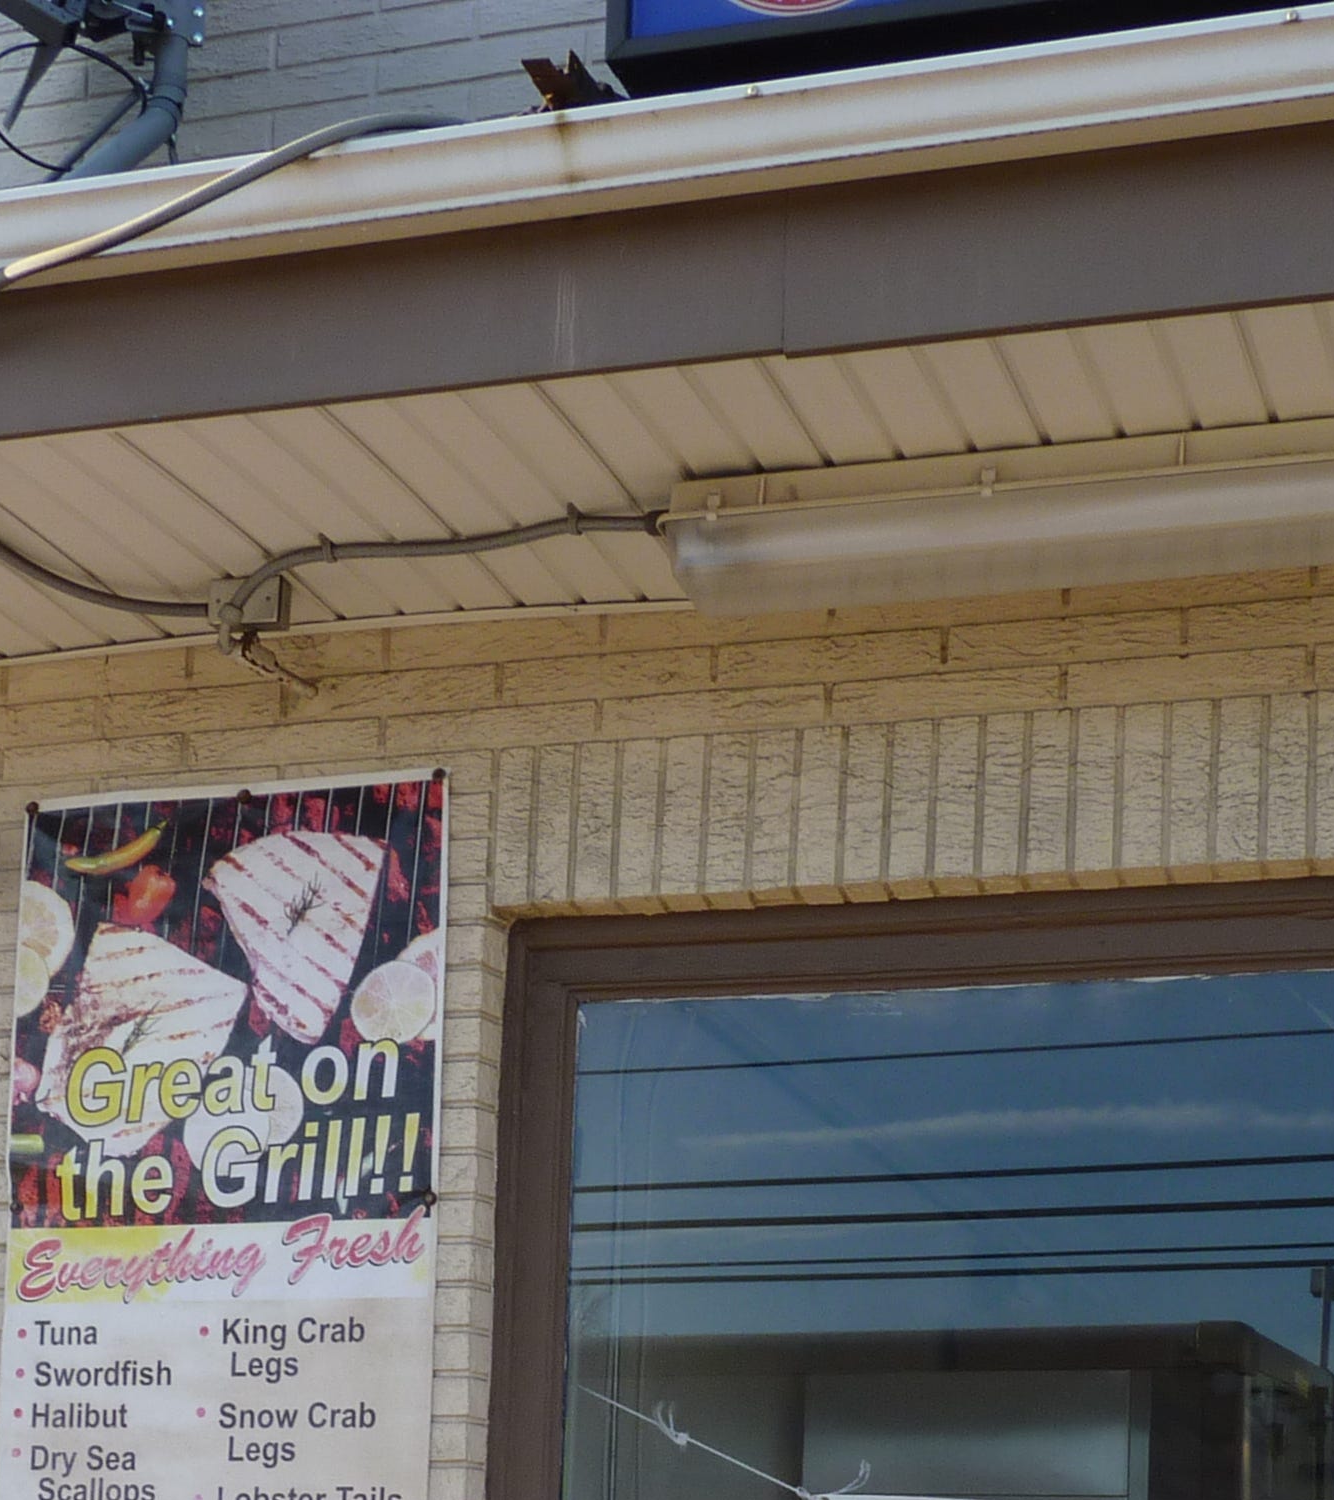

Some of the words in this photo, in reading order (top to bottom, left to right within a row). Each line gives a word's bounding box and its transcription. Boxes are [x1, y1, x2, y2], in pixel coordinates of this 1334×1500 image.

[66, 1035, 279, 1127] Great
[301, 1038, 400, 1107] on
[56, 1140, 173, 1222] the
[202, 1112, 420, 1208] Grill!!
[17, 1228, 267, 1303] Everything
[280, 1205, 426, 1285] Fresh
[34, 1320, 98, 1346] Tuna
[221, 1318, 287, 1350] King
[297, 1317, 365, 1343] Crab
[34, 1360, 172, 1387] Swordfish
[230, 1352, 299, 1383] Legs
[30, 1403, 128, 1429] Halibut
[219, 1403, 298, 1429] Snow
[307, 1402, 376, 1429] Crab
[30, 1446, 76, 1477] Dry
[86, 1445, 136, 1471] Sea
[227, 1436, 296, 1468] Legs
